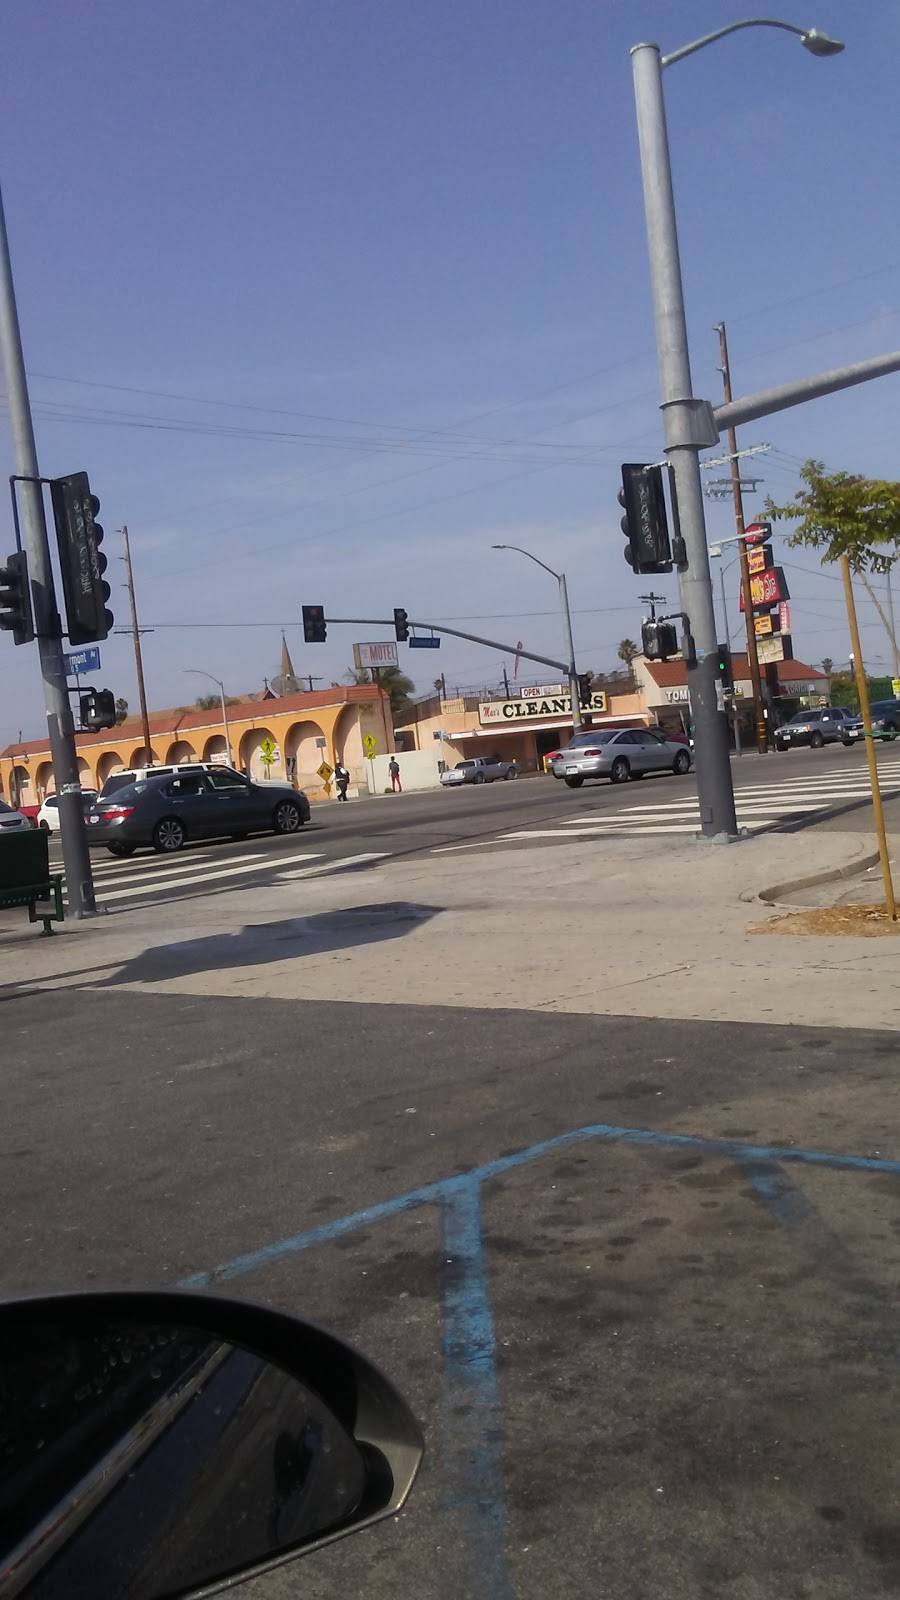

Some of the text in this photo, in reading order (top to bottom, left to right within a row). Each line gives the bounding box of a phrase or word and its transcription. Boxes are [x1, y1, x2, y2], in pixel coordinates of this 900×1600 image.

[369, 645, 397, 661] MOTEL
[523, 688, 541, 698] OPEN
[503, 694, 604, 718] CLEANRS
